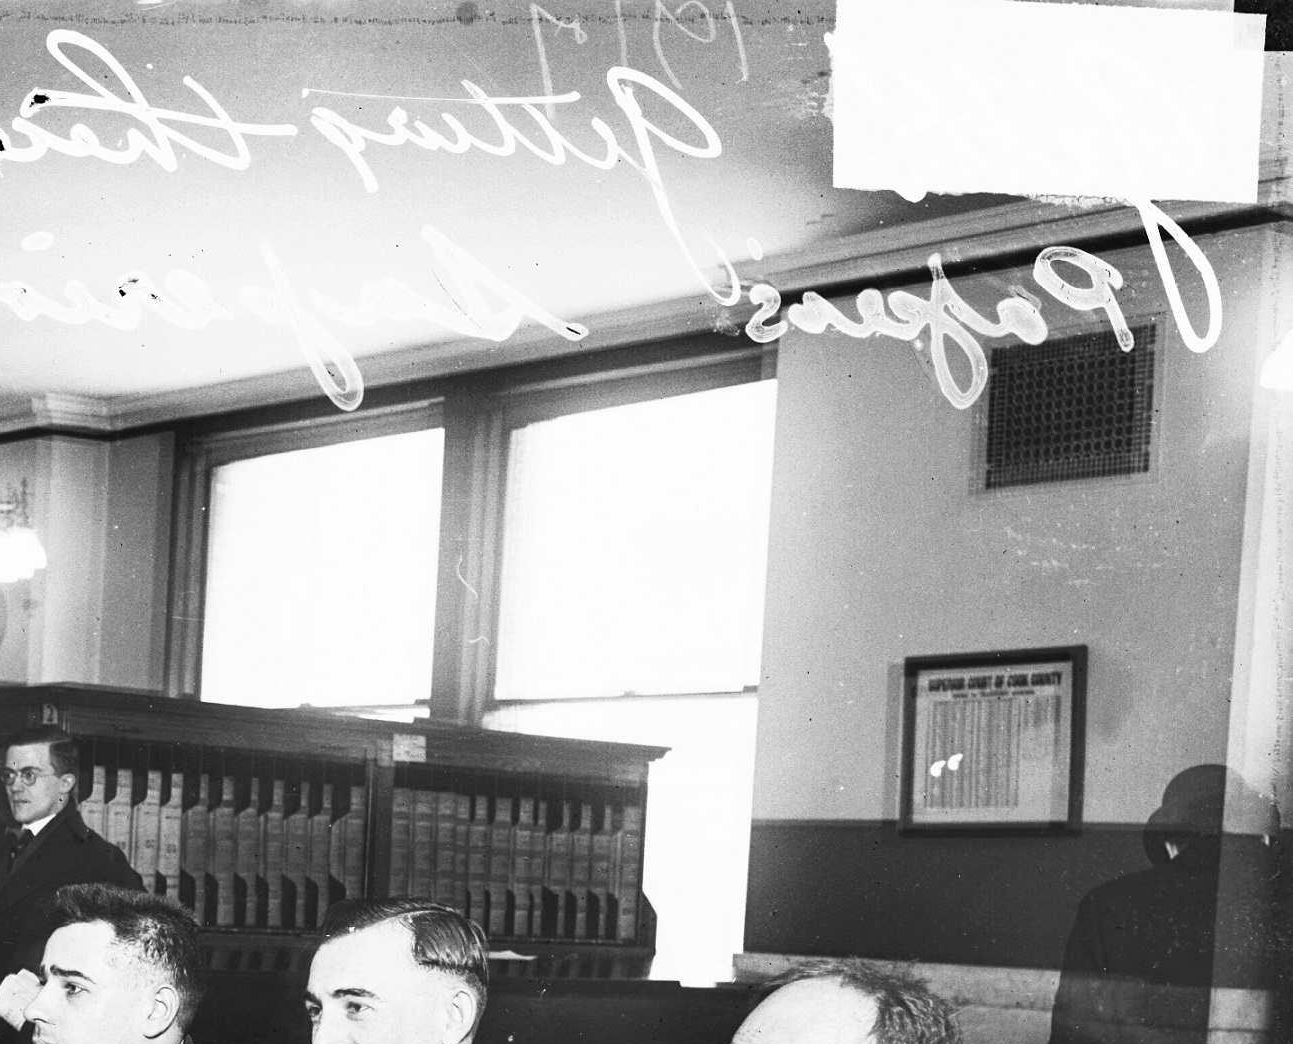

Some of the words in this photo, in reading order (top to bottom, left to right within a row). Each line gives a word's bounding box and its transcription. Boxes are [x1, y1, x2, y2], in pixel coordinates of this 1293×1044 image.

[968, 675, 993, 689] COURT
[995, 674, 1005, 688] OF
[1031, 670, 1062, 686] COUNTY
